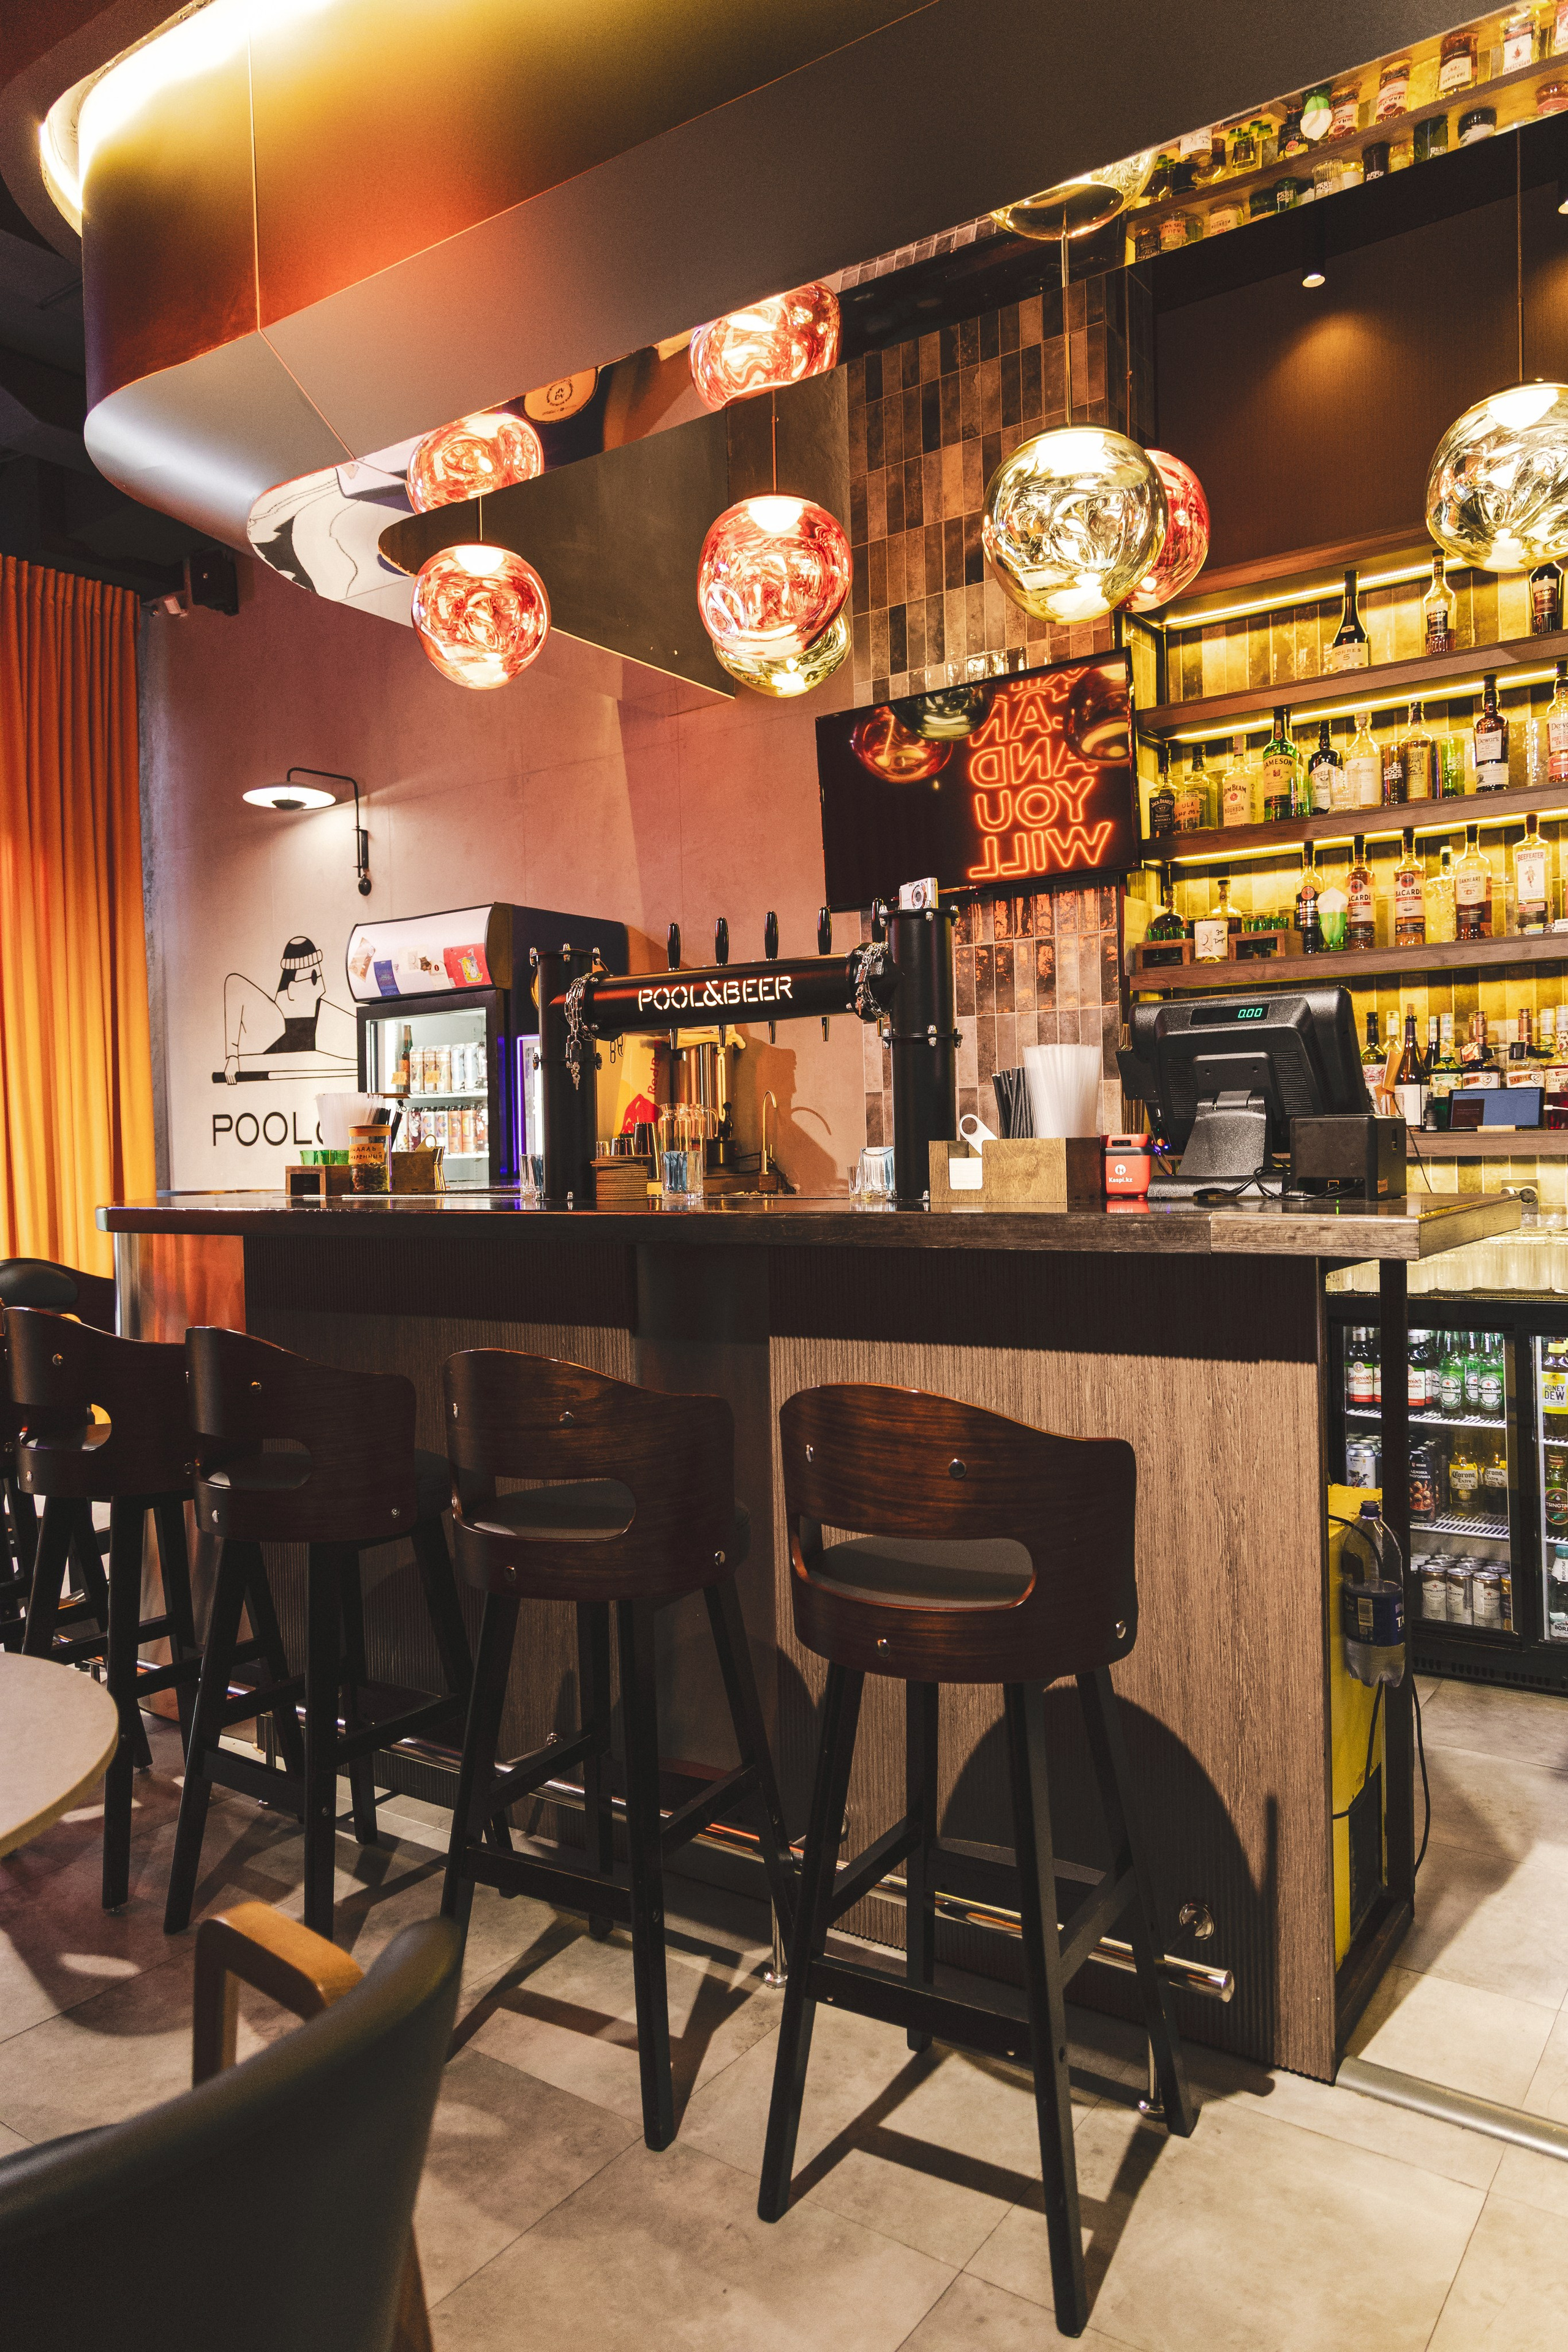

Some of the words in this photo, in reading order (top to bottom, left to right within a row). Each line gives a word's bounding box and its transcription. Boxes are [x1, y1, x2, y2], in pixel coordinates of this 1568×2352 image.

[1335, 647, 1362, 656] TORRES
[1264, 758, 1293, 771] JAMESON
[1313, 769, 1329, 780] TEEL
[1232, 784, 1246, 793] BEAM
[1517, 852, 1544, 862] BEEFEATER
[1348, 892, 1371, 902] ACARDÍ
[638, 976, 793, 1012] POOL&BEER
[1237, 1008, 1263, 1019] 0.00
[647, 1067, 660, 1095] Red
[1544, 1390, 1565, 1401] DEW
